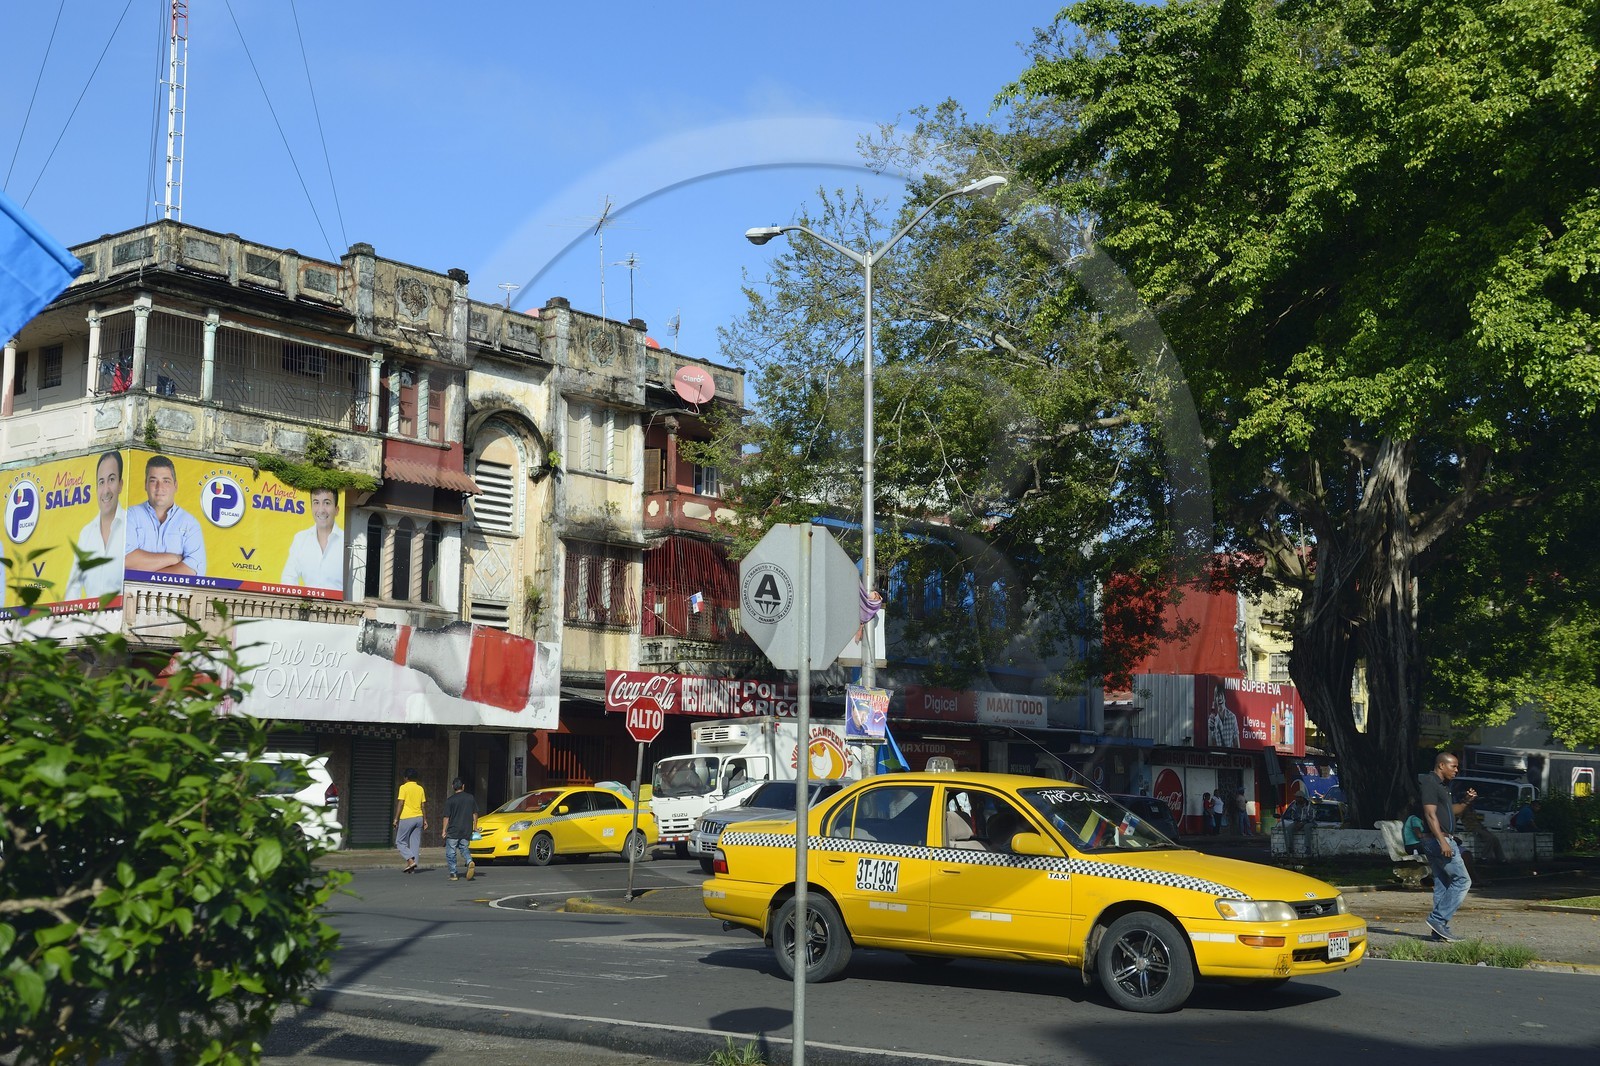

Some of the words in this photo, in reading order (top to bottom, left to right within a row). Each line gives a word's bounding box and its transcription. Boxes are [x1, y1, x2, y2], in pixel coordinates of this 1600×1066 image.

[682, 374, 702, 383] Claro
[53, 470, 86, 494] Miguel
[261, 481, 298, 500] Miguel
[44, 485, 92, 511] SALAS
[252, 494, 305, 515] SALAS
[231, 561, 263, 572] VARELA
[150, 575, 190, 584] ALCALDE
[195, 579, 217, 587] 2014
[261, 585, 303, 595] DIPUTADO
[306, 589, 326, 598] 2014
[87, 601, 100, 610] 201
[266, 639, 306, 667] Pub
[309, 642, 349, 668] Bar
[250, 667, 370, 702] TOMMY
[608, 672, 679, 710] Coca-Cola
[681, 677, 740, 715] RESTAURANTE
[743, 681, 798, 701] POLL
[1224, 677, 1240, 691] MINI
[1241, 680, 1266, 694] SUPER
[1267, 682, 1282, 696] EVA
[924, 694, 958, 714] Digicel
[986, 697, 1014, 713] MAXI
[1016, 699, 1043, 716] TODO
[629, 708, 661, 730] ALTO
[1243, 716, 1260, 728] Lleva
[812, 726, 844, 750] CAMPEON
[1242, 728, 1267, 740] favorita
[857, 858, 899, 886] 3T-1361
[1049, 872, 1070, 880] TAXI
[857, 882, 894, 892] COLON
